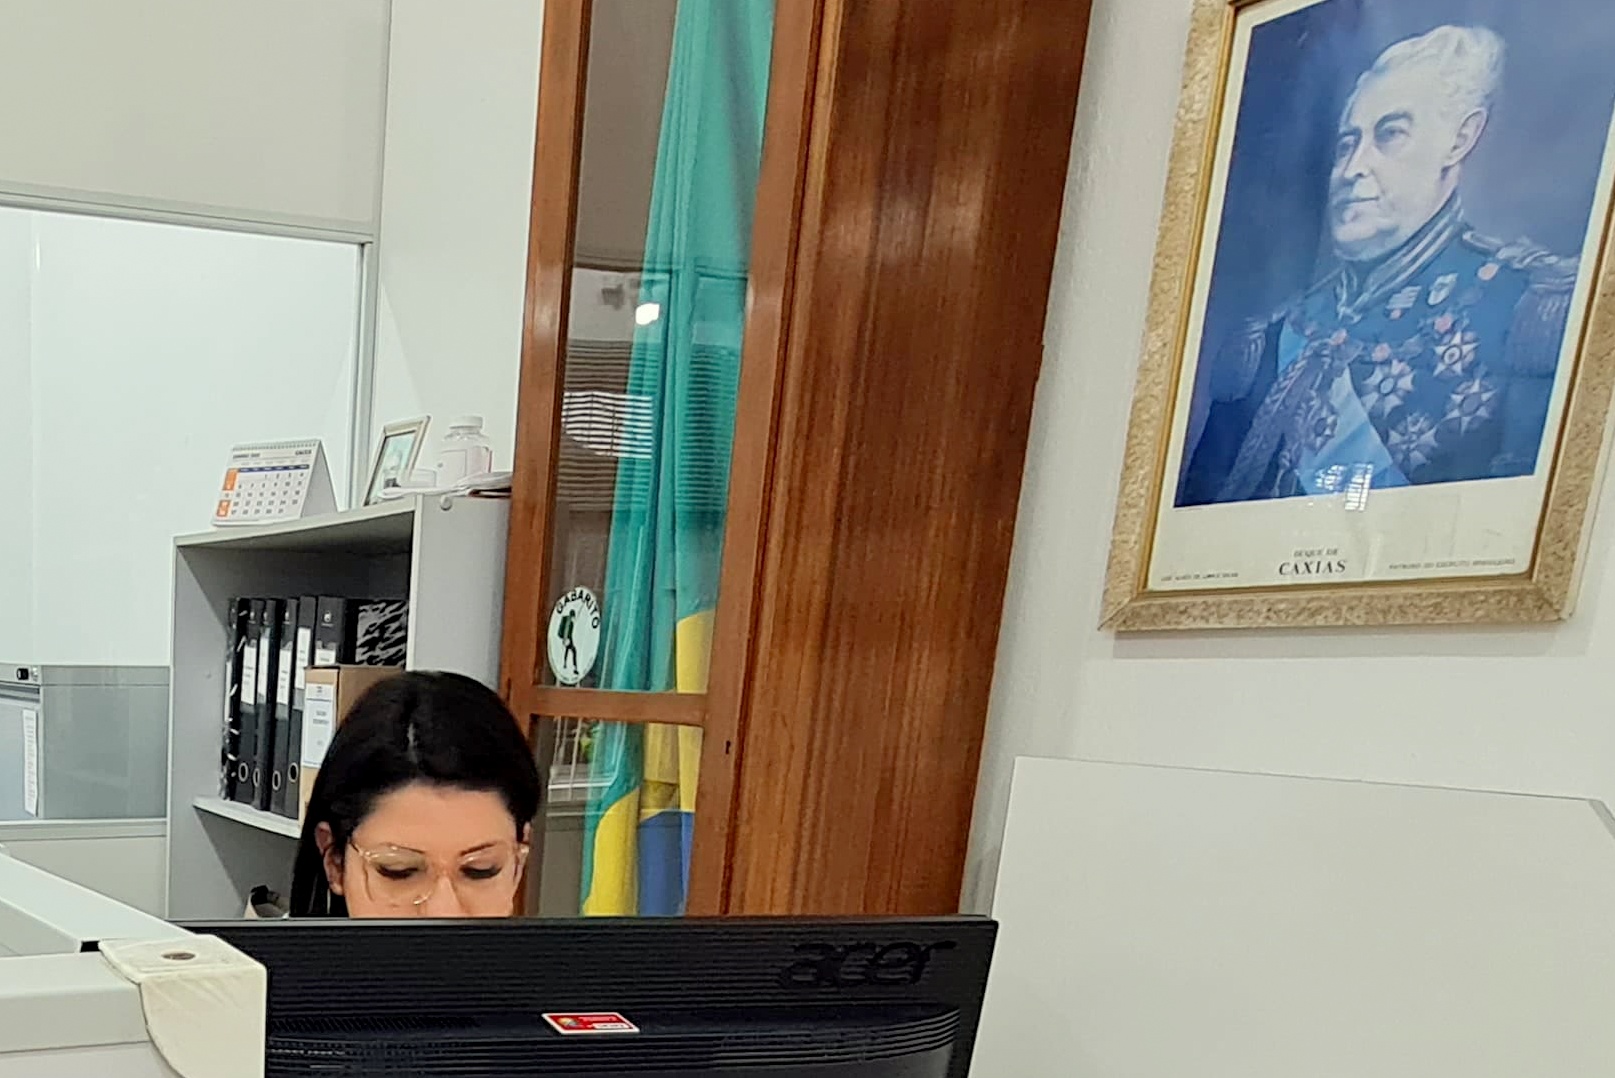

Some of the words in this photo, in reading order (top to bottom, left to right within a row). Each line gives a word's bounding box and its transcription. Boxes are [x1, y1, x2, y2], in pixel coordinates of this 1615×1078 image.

[1278, 560, 1346, 575] CAXIAS
[556, 590, 599, 629] GABARITO
[782, 940, 957, 985] acer
